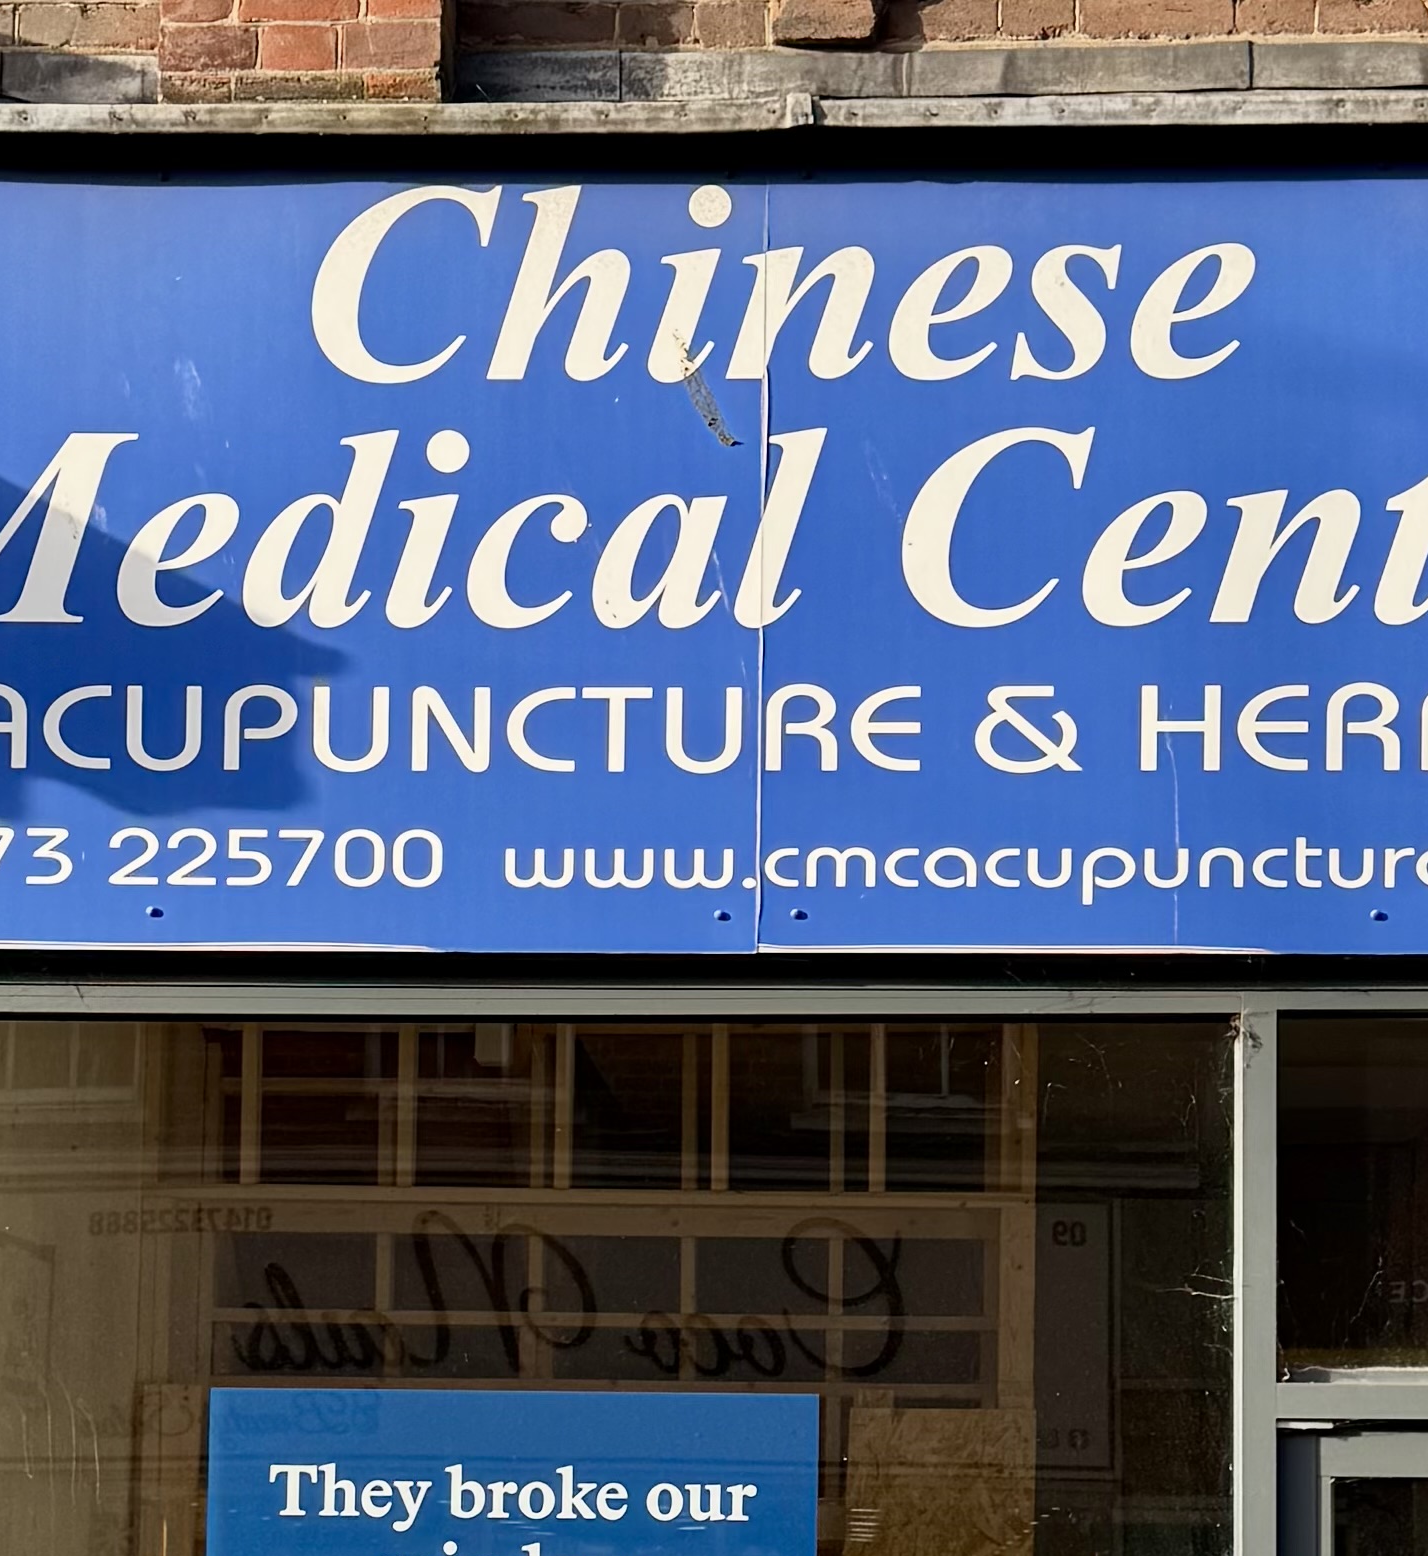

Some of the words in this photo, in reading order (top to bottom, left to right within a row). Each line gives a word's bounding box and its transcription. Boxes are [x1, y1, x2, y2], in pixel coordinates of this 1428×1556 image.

[311, 184, 1256, 384] Chinese
[975, 686, 1082, 773] &
[109, 828, 442, 887] 225700
[270, 1463, 432, 1531] They
[445, 1464, 627, 1520] broke
[647, 1483, 757, 1521] our
